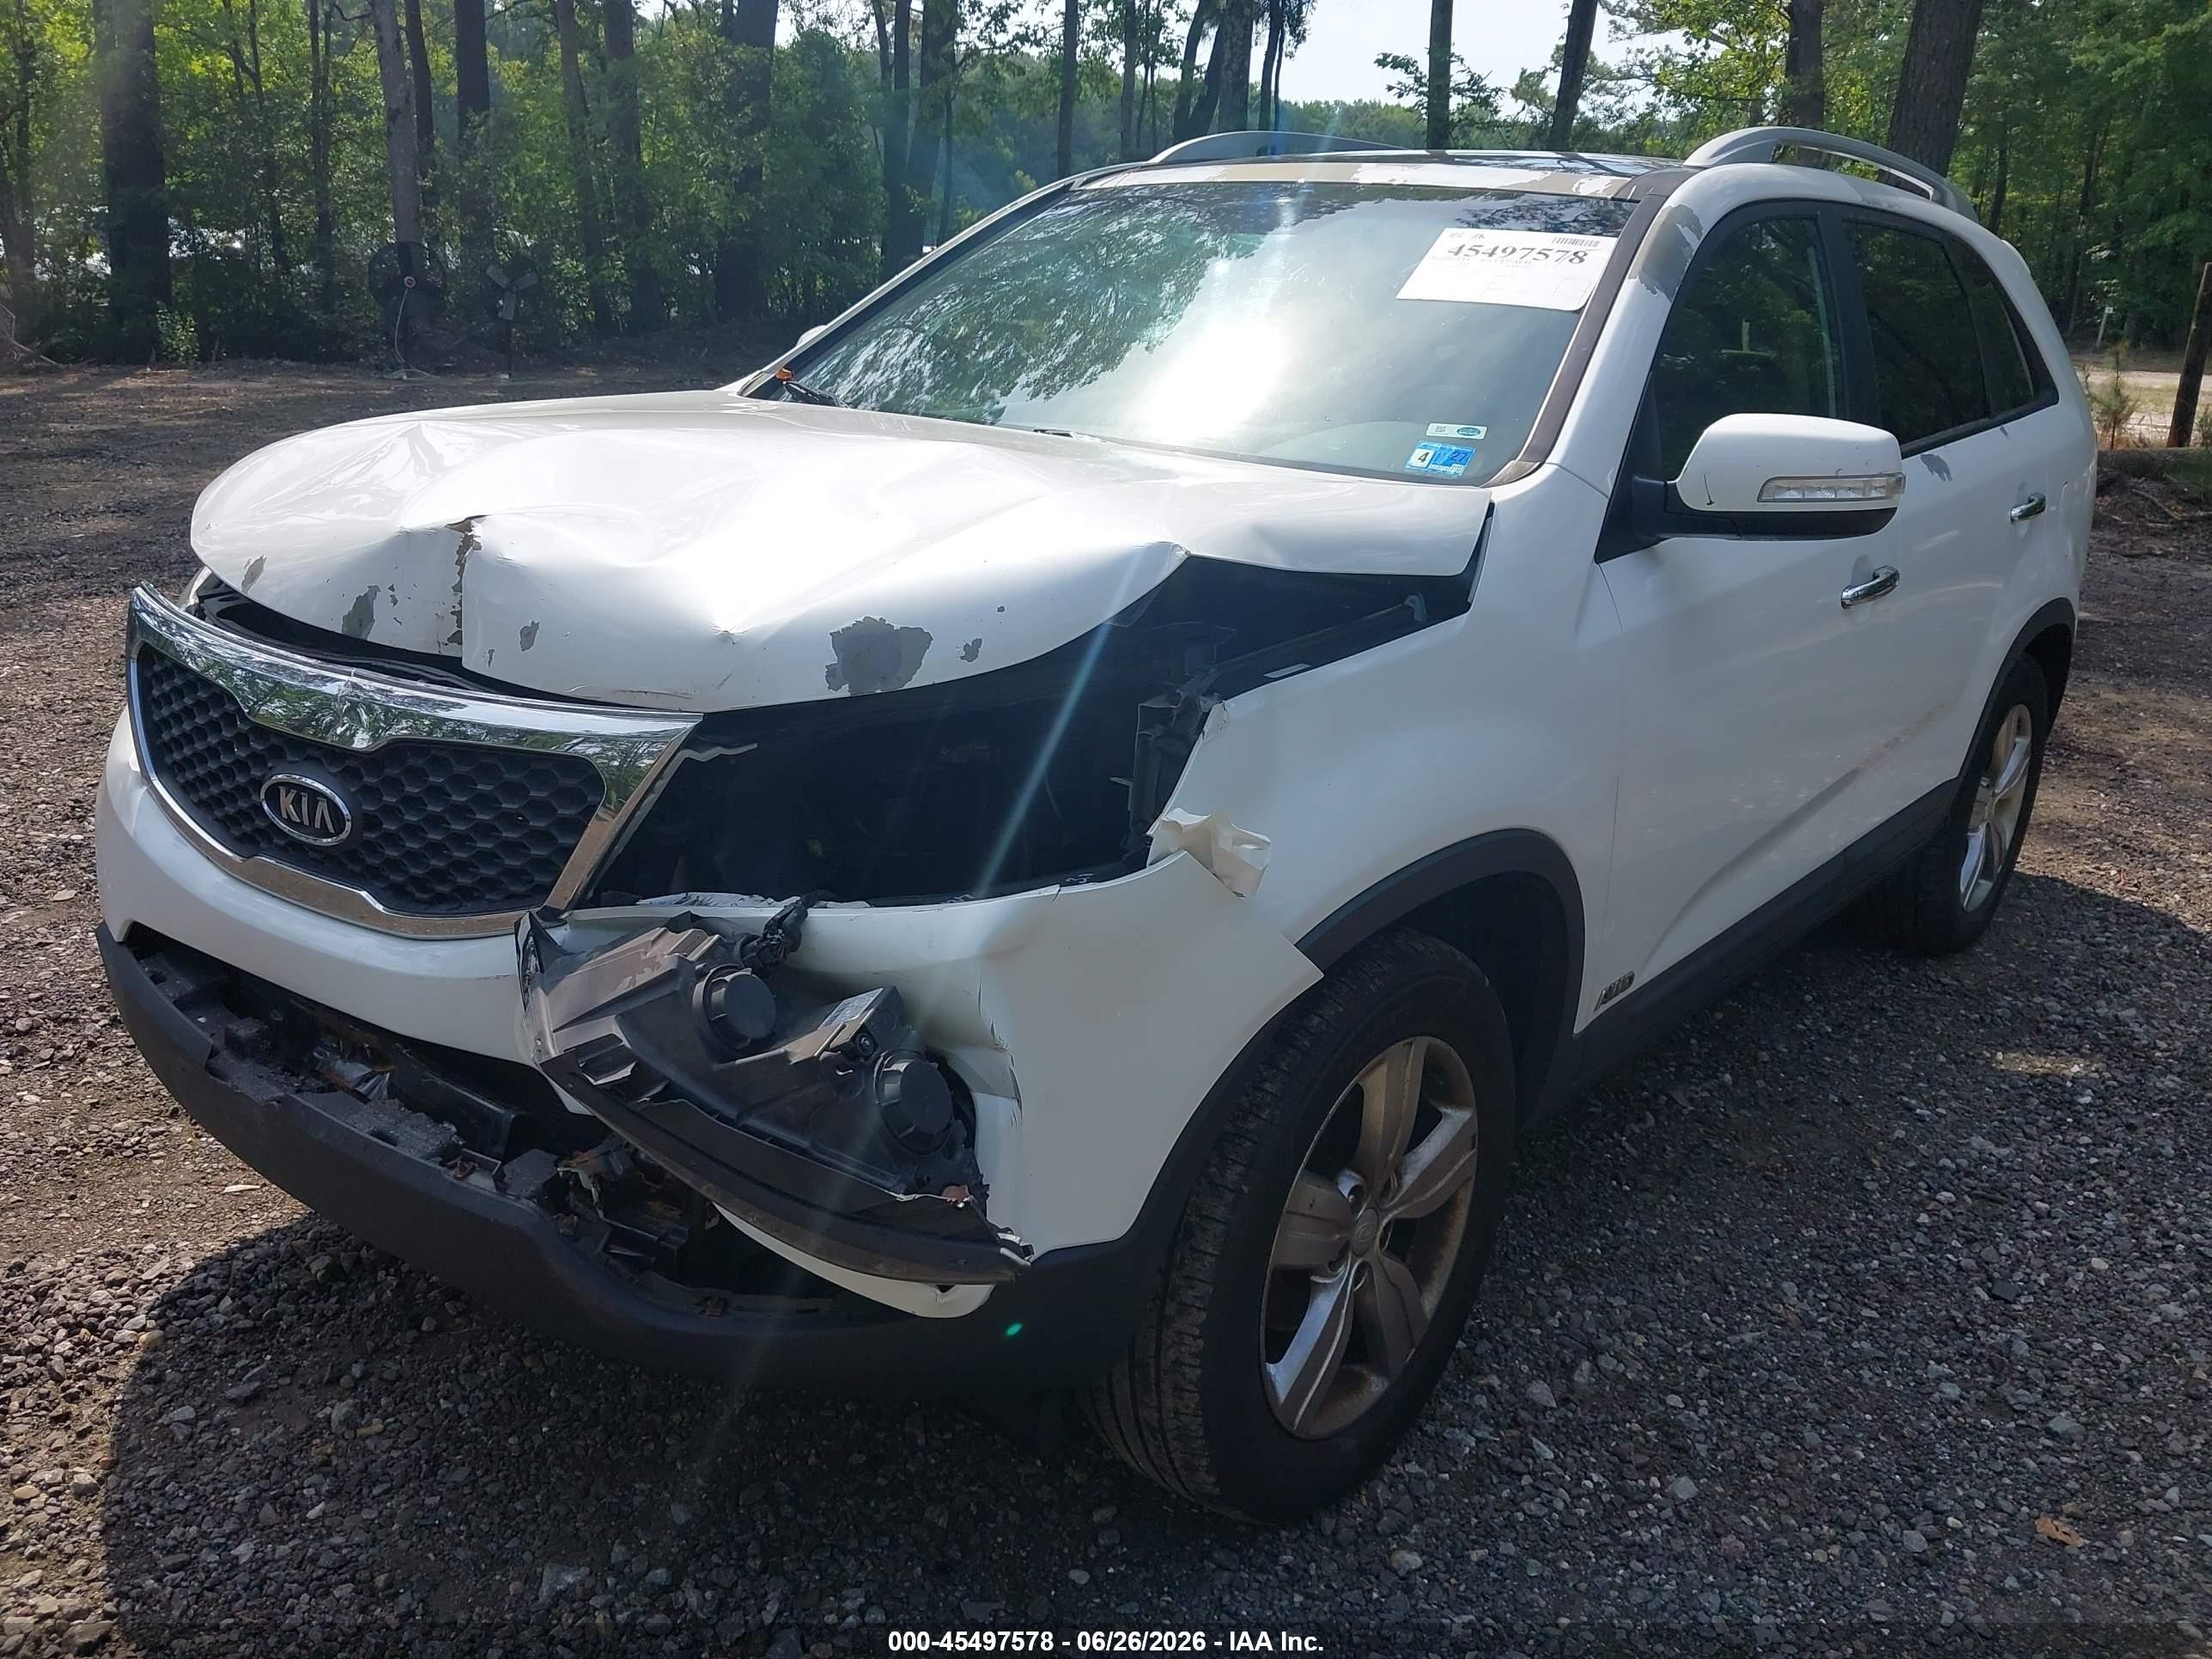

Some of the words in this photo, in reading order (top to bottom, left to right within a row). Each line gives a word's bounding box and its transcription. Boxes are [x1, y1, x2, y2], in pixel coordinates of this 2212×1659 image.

[1447, 243, 1589, 265] 45497578
[1418, 452, 1431, 464] 4
[1450, 451, 1468, 463] 27
[278, 786, 336, 834] KIA
